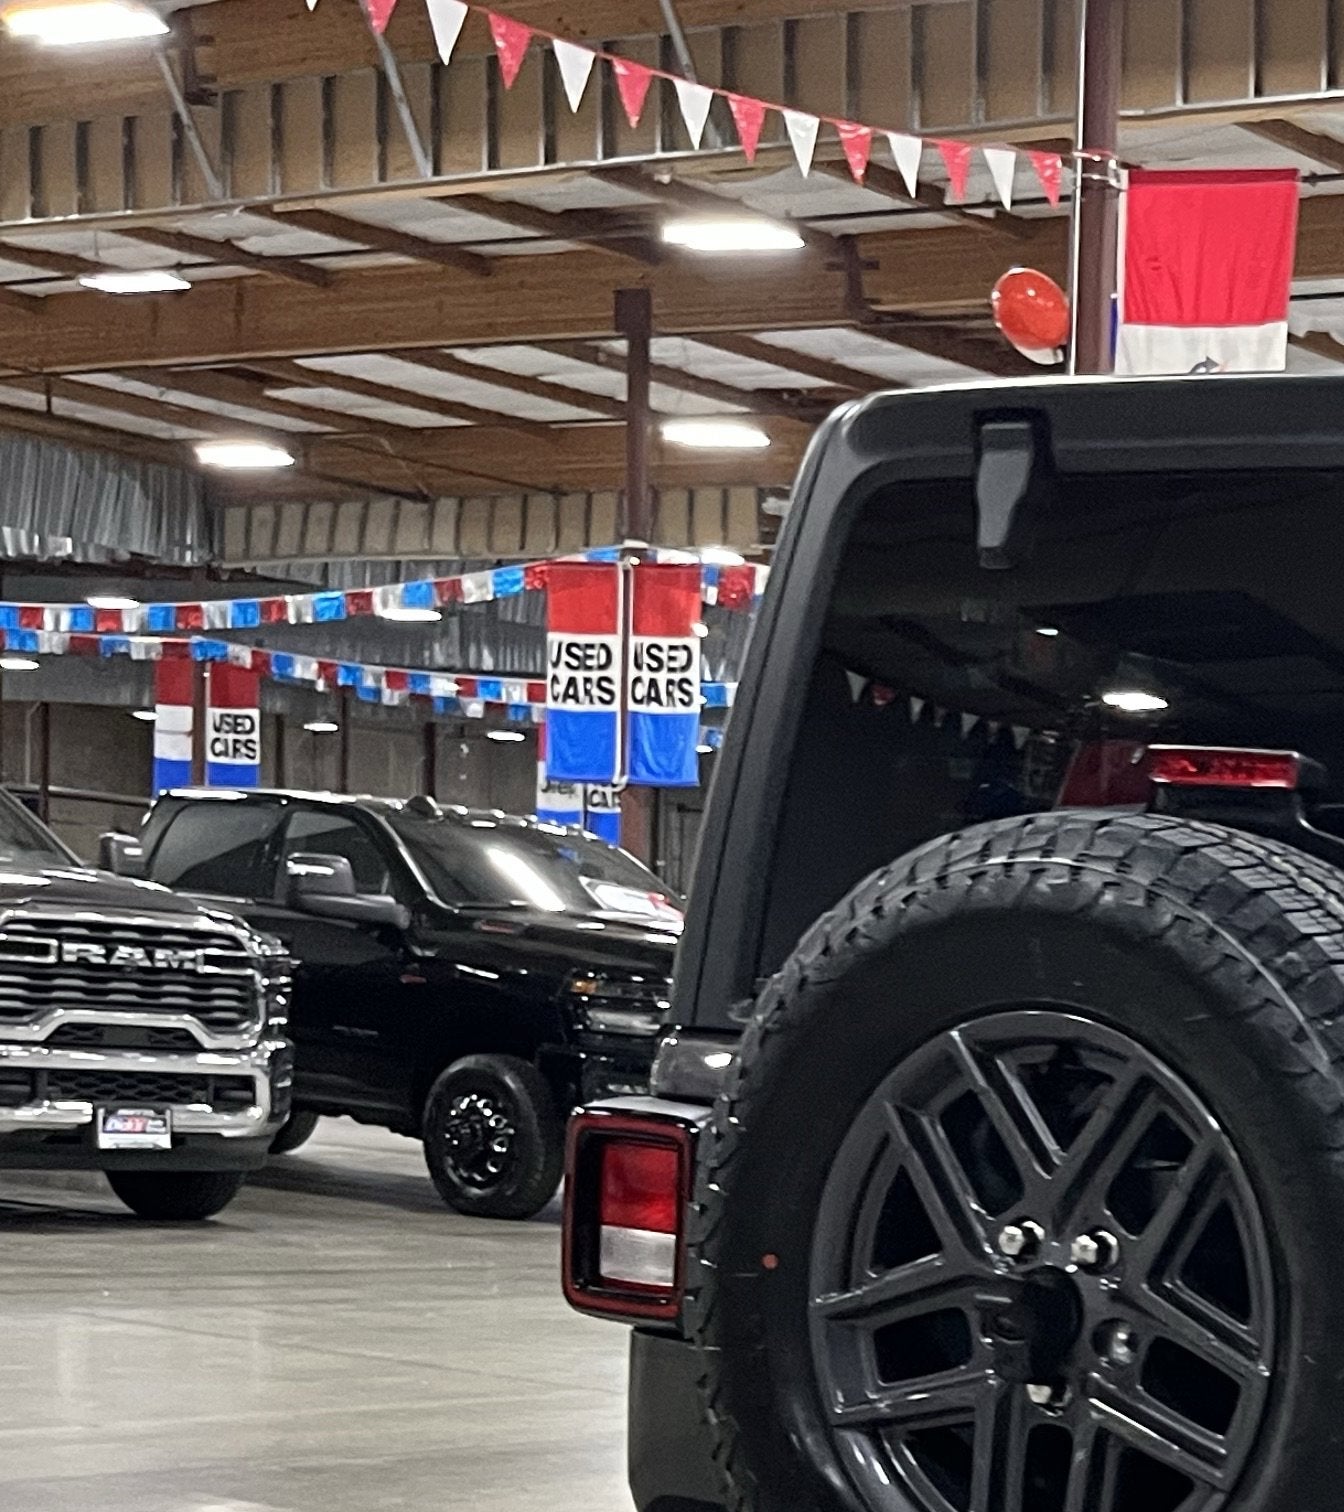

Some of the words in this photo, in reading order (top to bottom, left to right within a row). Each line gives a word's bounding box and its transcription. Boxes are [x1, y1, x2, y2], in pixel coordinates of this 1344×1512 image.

[551, 641, 613, 672] USED
[633, 642, 693, 673] USED
[550, 674, 616, 705] CARS
[631, 675, 694, 707] CARS
[212, 712, 256, 735] USED
[61, 943, 197, 970] RAM
